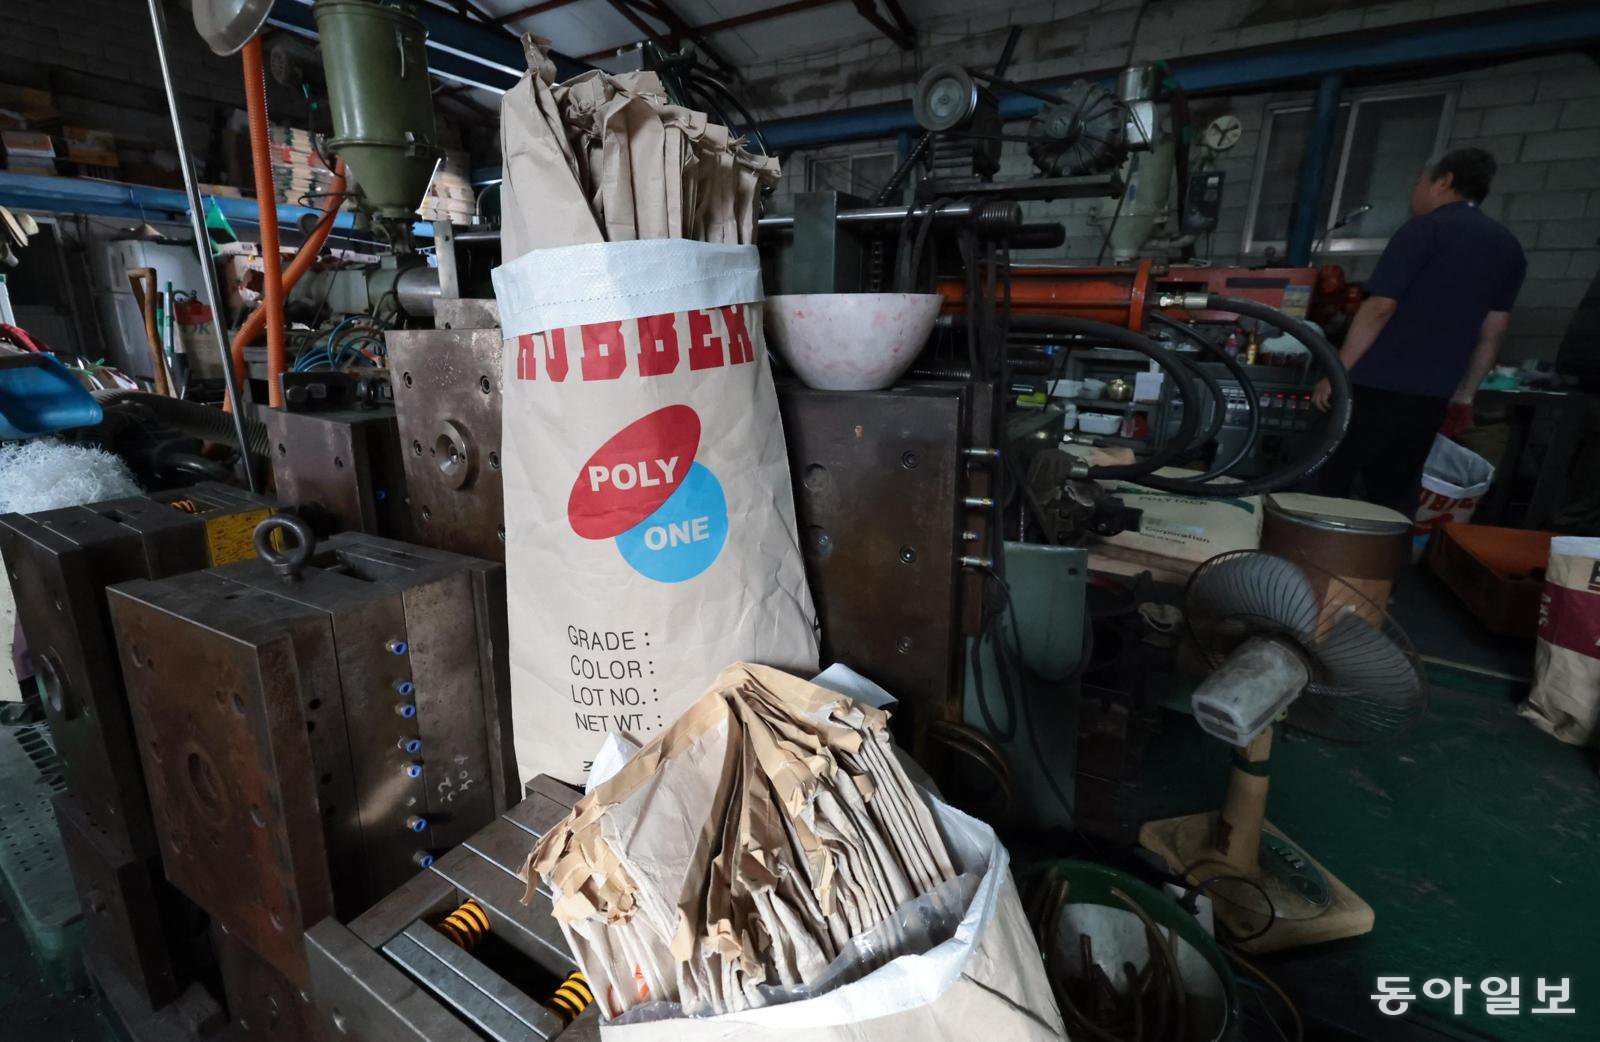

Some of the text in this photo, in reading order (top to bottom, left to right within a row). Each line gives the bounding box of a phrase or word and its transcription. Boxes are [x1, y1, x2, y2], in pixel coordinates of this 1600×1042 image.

[588, 456, 679, 492] POLY
[644, 516, 709, 551] ONE
[571, 684, 604, 706] LOT
[575, 712, 609, 732] NET
